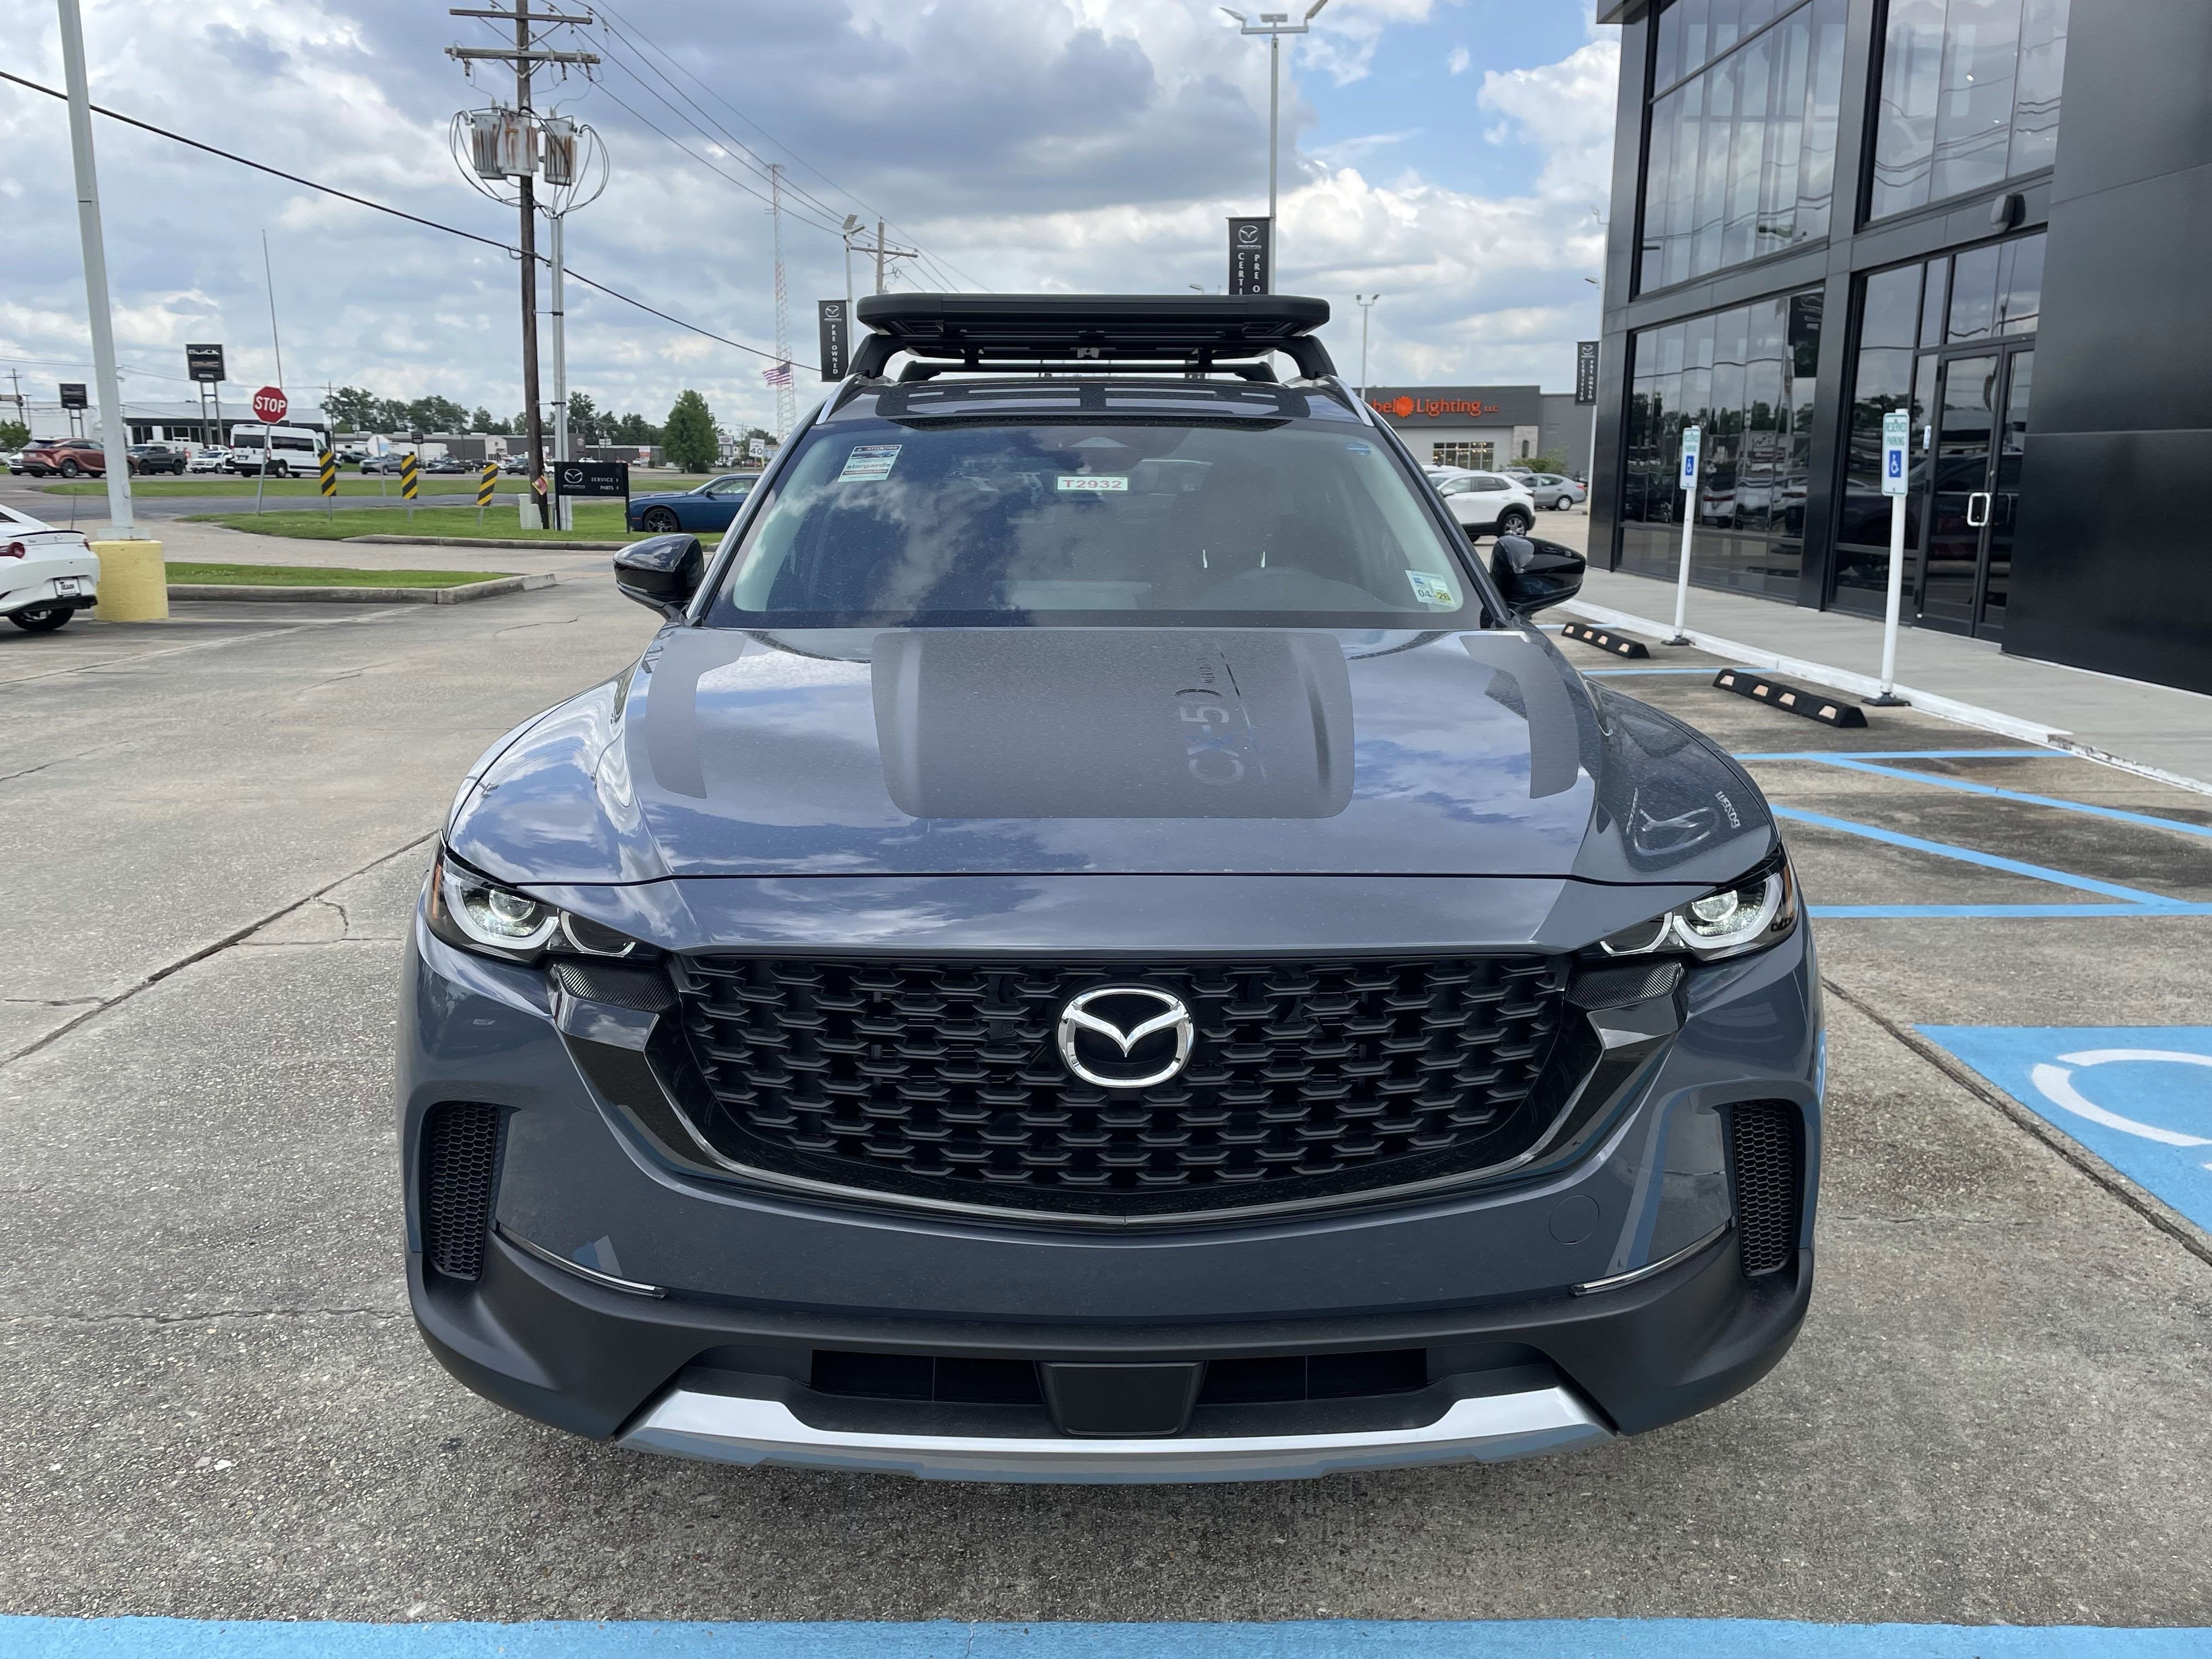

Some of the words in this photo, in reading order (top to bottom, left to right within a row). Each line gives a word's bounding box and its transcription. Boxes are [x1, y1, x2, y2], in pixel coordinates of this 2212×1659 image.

[831, 345, 839, 374] OWNED
[254, 396, 286, 413] STOP
[1372, 399, 1396, 413] bel
[1416, 398, 1481, 417] Lighting
[1062, 479, 1122, 488] T2932
[1418, 589, 1431, 597] 04
[1437, 592, 1451, 601] 26
